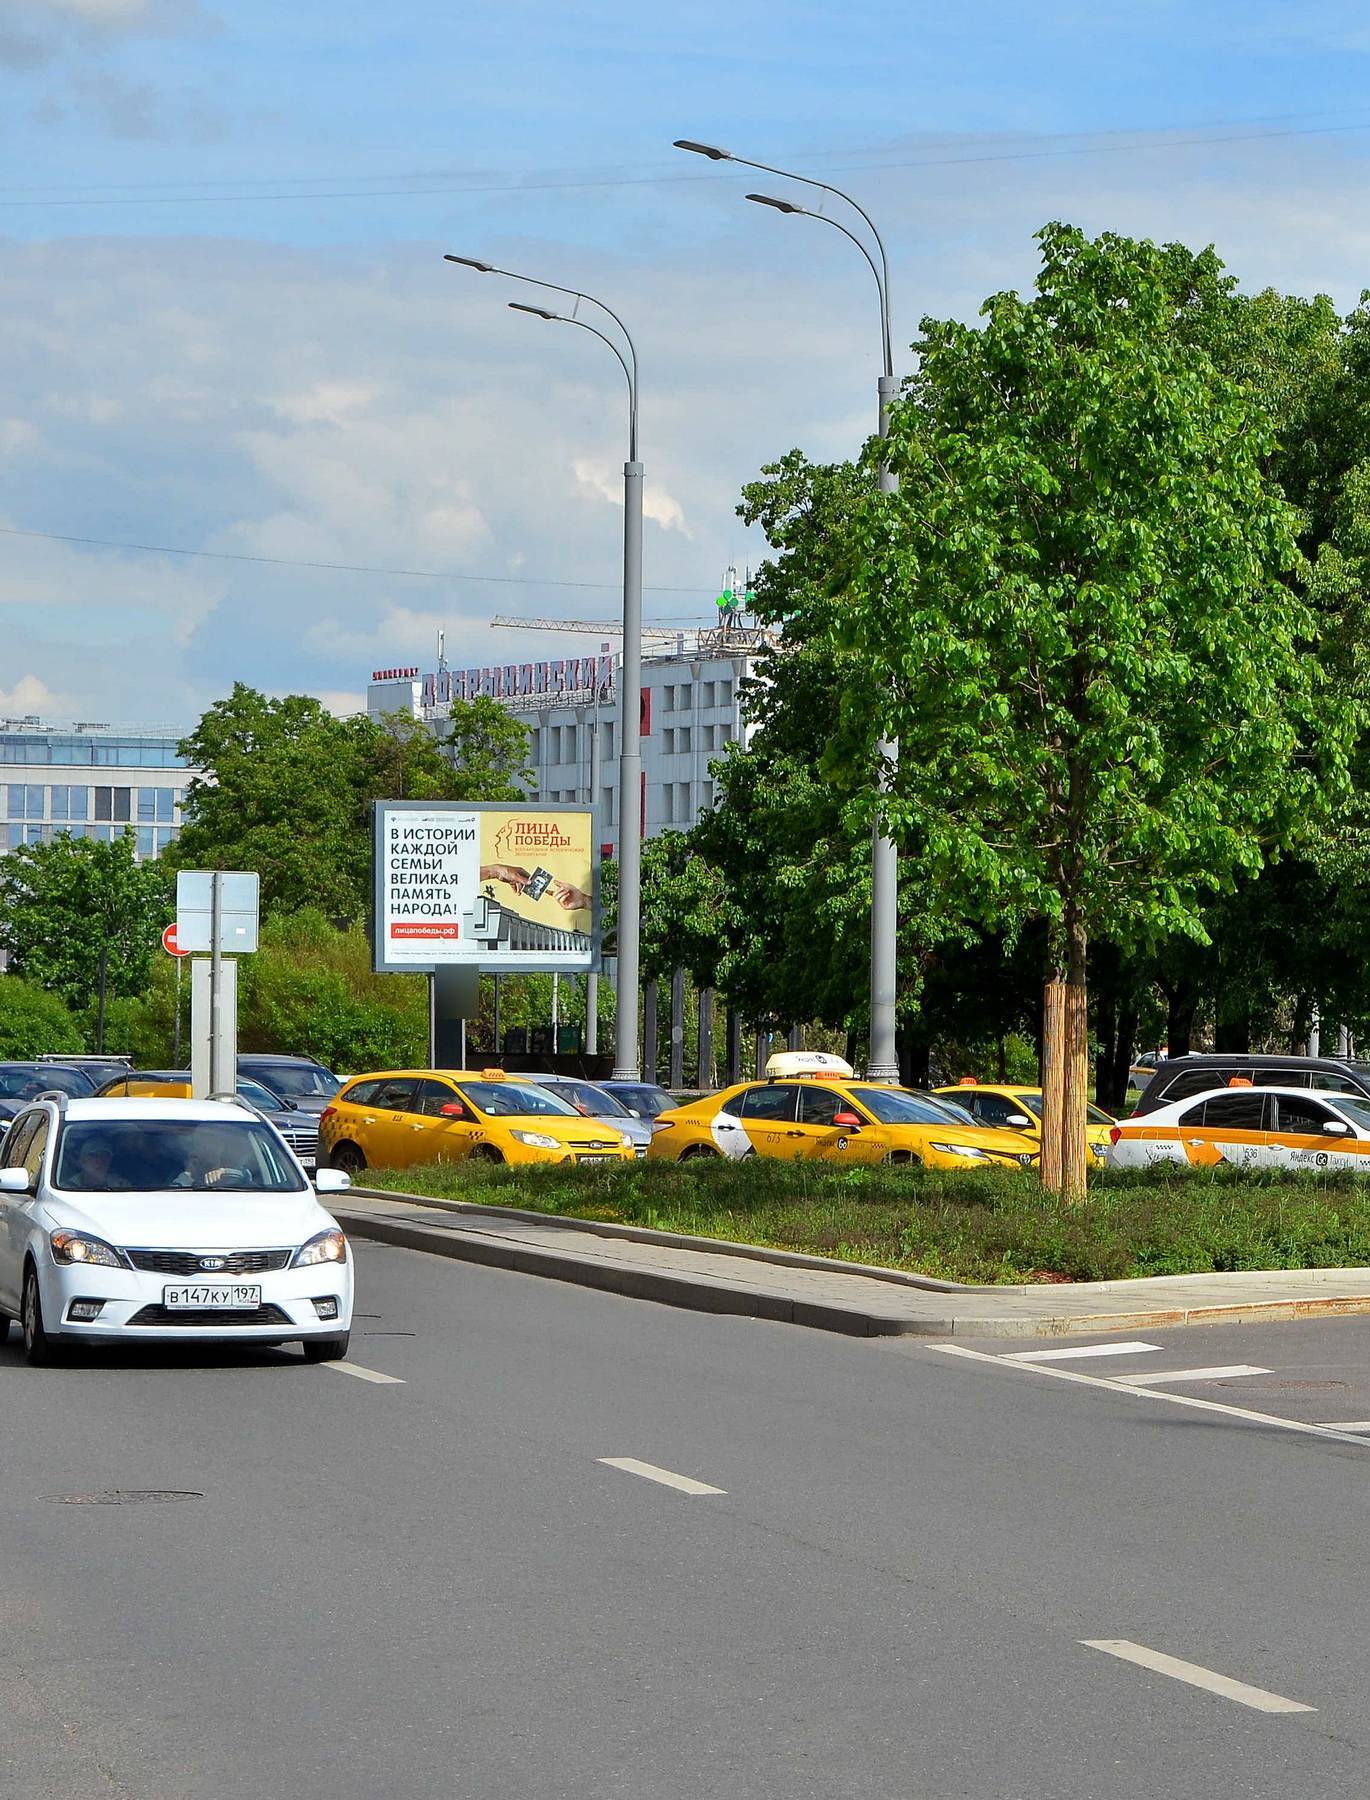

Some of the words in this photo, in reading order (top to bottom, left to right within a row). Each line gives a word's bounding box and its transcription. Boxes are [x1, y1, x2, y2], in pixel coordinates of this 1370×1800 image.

[390, 828, 399, 840] В
[403, 828, 475, 841] ИСТОРИИ
[514, 823, 561, 838] ЛИЦА
[514, 835, 571, 848] ПОБЕДЫ
[390, 841, 458, 856] КАЖДОЙ
[390, 858, 443, 870] СЕМЬИ
[390, 873, 459, 885] ВЕЛИКАЯ
[390, 888, 452, 900] ПАМЯТЬ
[390, 903, 457, 916] НАРОДА!
[395, 927, 456, 937] лицапобеды.рф
[203, 1260, 221, 1268] KIA
[170, 1288, 229, 1303] В147КУ
[233, 1287, 256, 1299] 197
